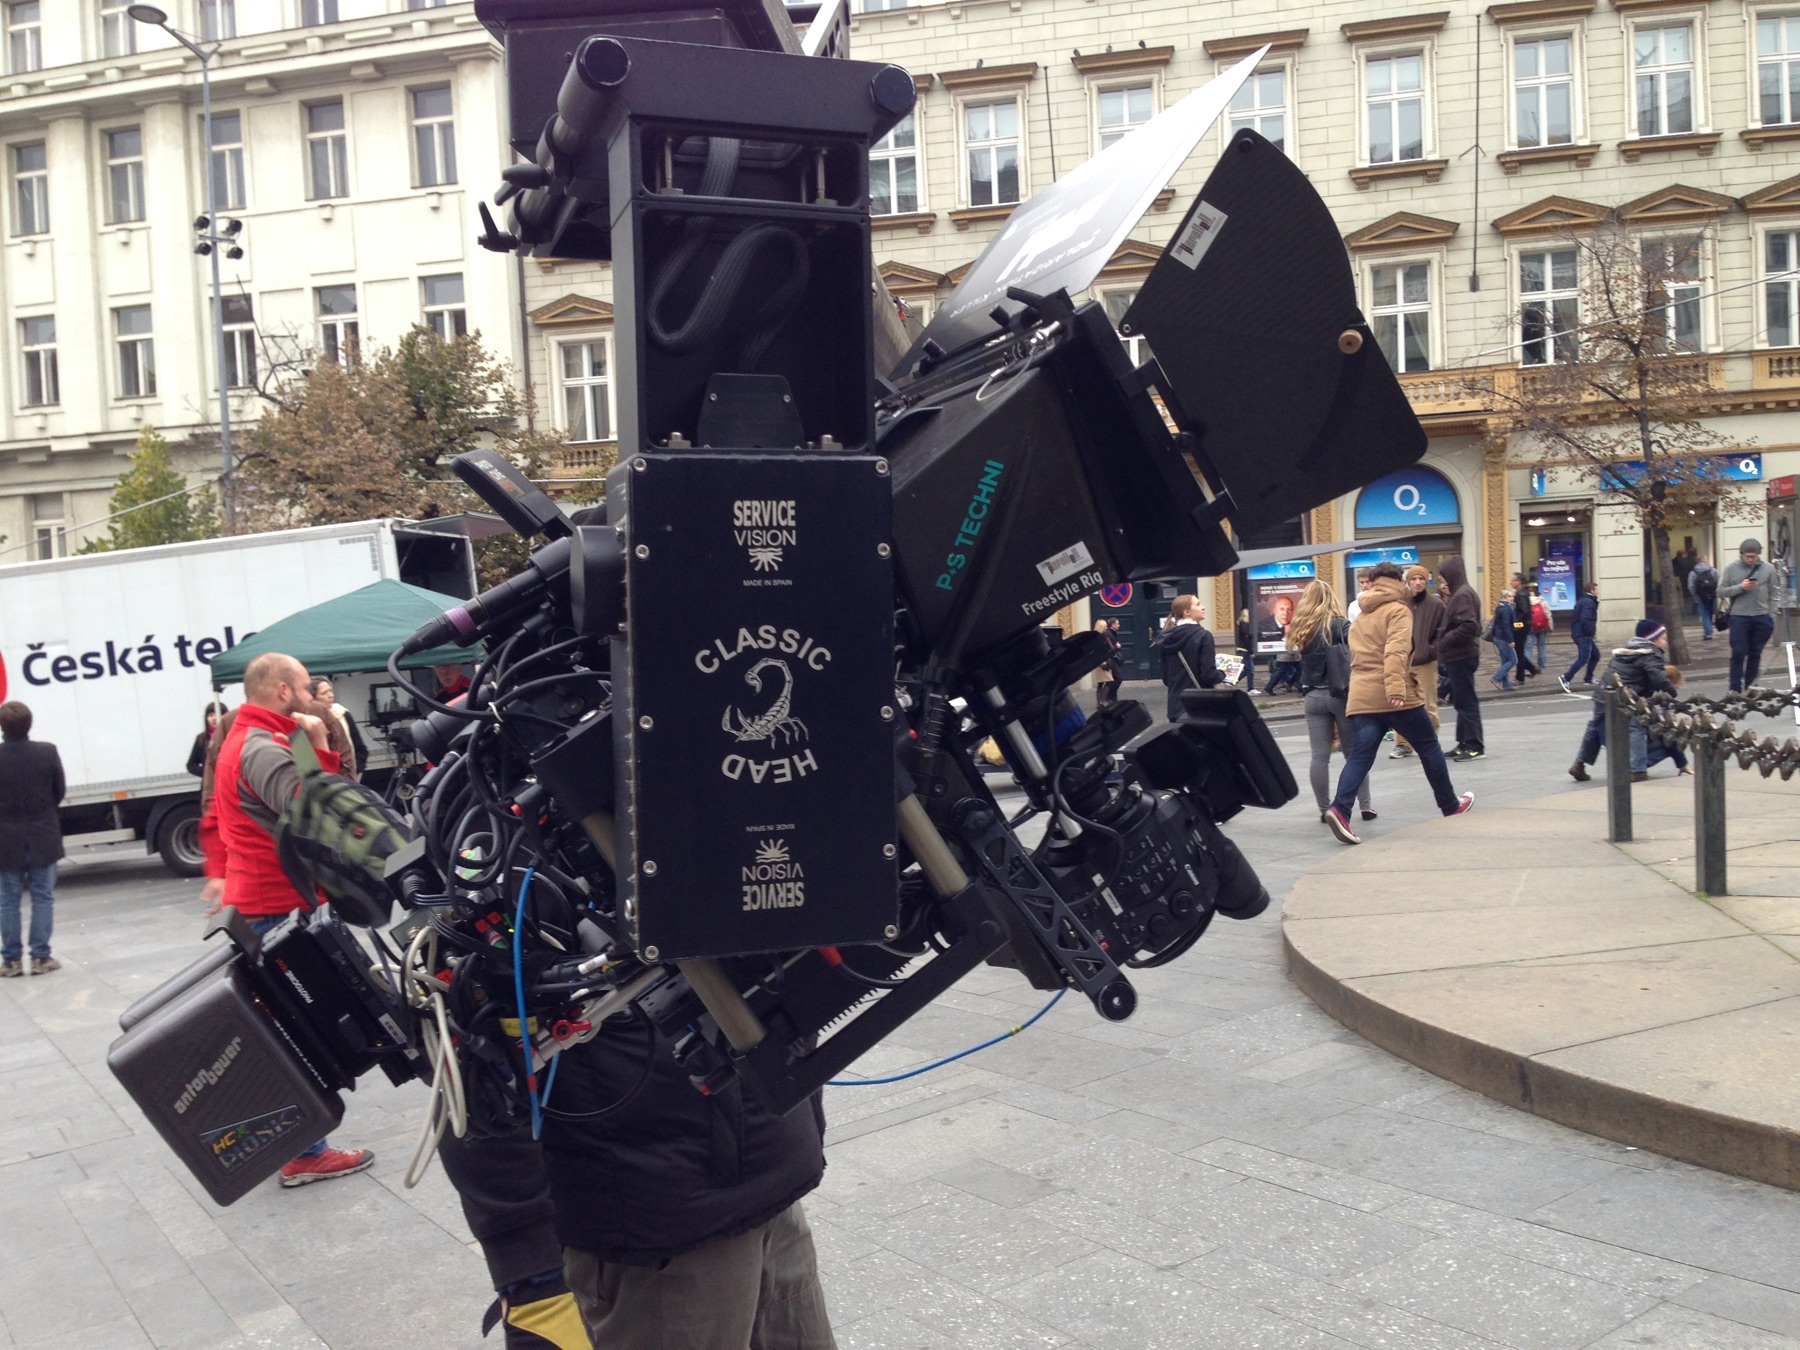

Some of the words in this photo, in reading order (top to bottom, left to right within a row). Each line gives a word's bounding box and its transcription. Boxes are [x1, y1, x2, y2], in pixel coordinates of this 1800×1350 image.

[1739, 459, 1759, 475] O2
[733, 500, 796, 527] SERVICE
[1393, 484, 1427, 516] O2
[734, 529, 796, 547] VISION
[743, 579, 762, 587] MADE
[763, 579, 772, 587] IN
[773, 579, 792, 587] SPAIN
[935, 553, 967, 591] P+S
[1021, 583, 1080, 616] Freestyle
[1079, 569, 1103, 591] Rig
[22, 634, 164, 686] Česká
[173, 626, 258, 668] tel
[695, 624, 832, 674] CLASSIC
[721, 749, 818, 784] HEAD
[775, 823, 796, 831] MADE
[741, 862, 804, 881] VISION
[1184, 863, 1200, 886] Canon
[742, 881, 805, 912] SERVICE
[173, 1036, 243, 1115] antonbauer
